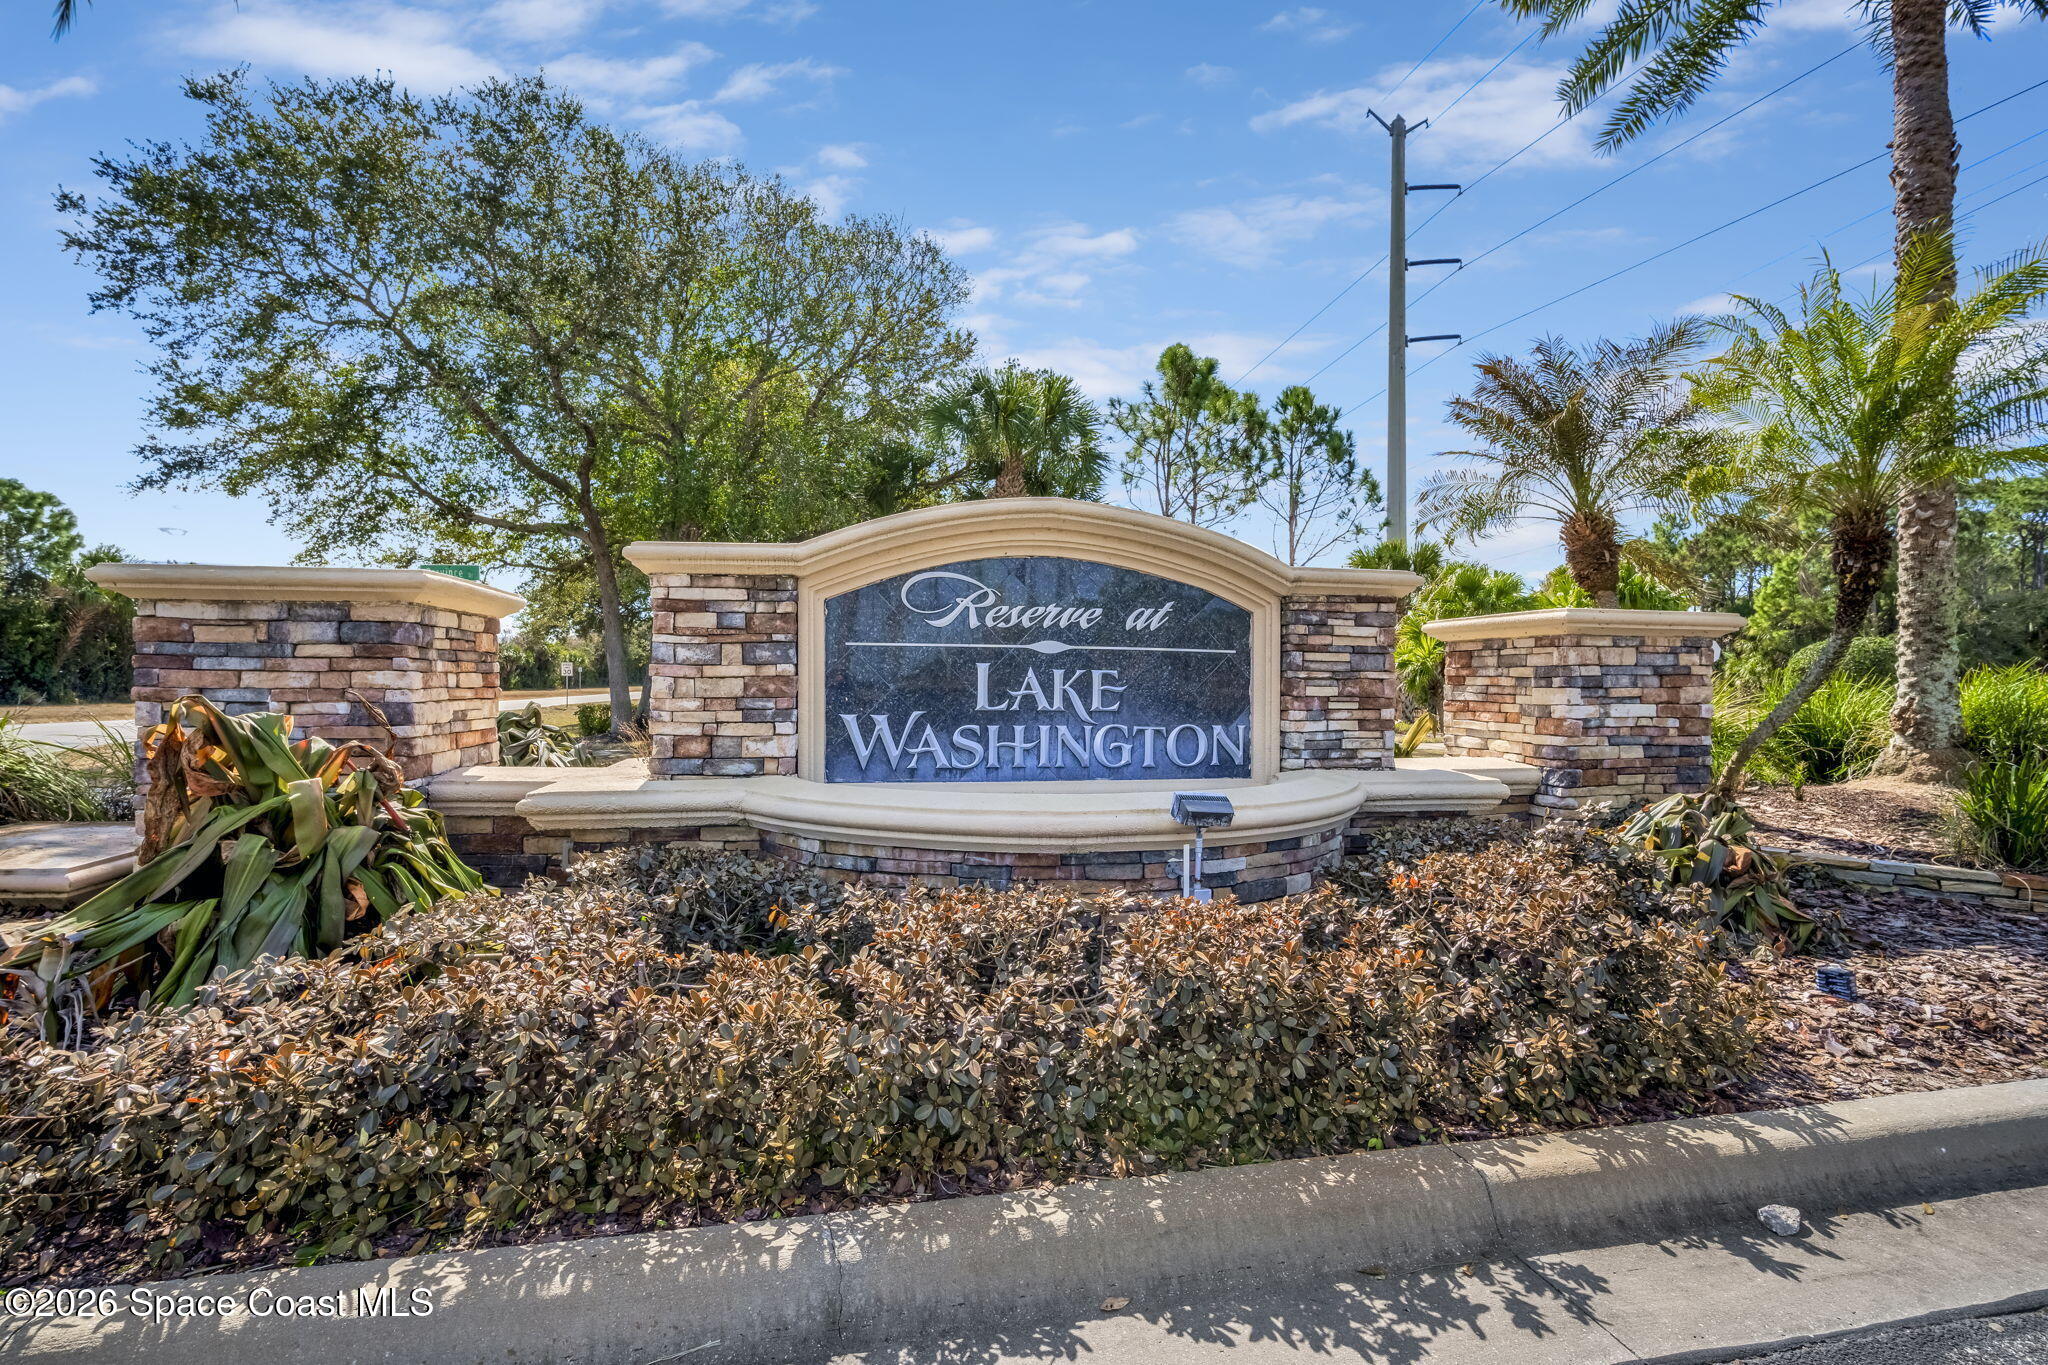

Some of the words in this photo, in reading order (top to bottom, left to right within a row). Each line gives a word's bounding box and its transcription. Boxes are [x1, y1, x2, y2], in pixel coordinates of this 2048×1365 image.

[900, 571, 1103, 630] Reserve
[1125, 600, 1174, 632] at
[975, 662, 1128, 725] LAKE
[839, 711, 1246, 770] WASHINGTON
